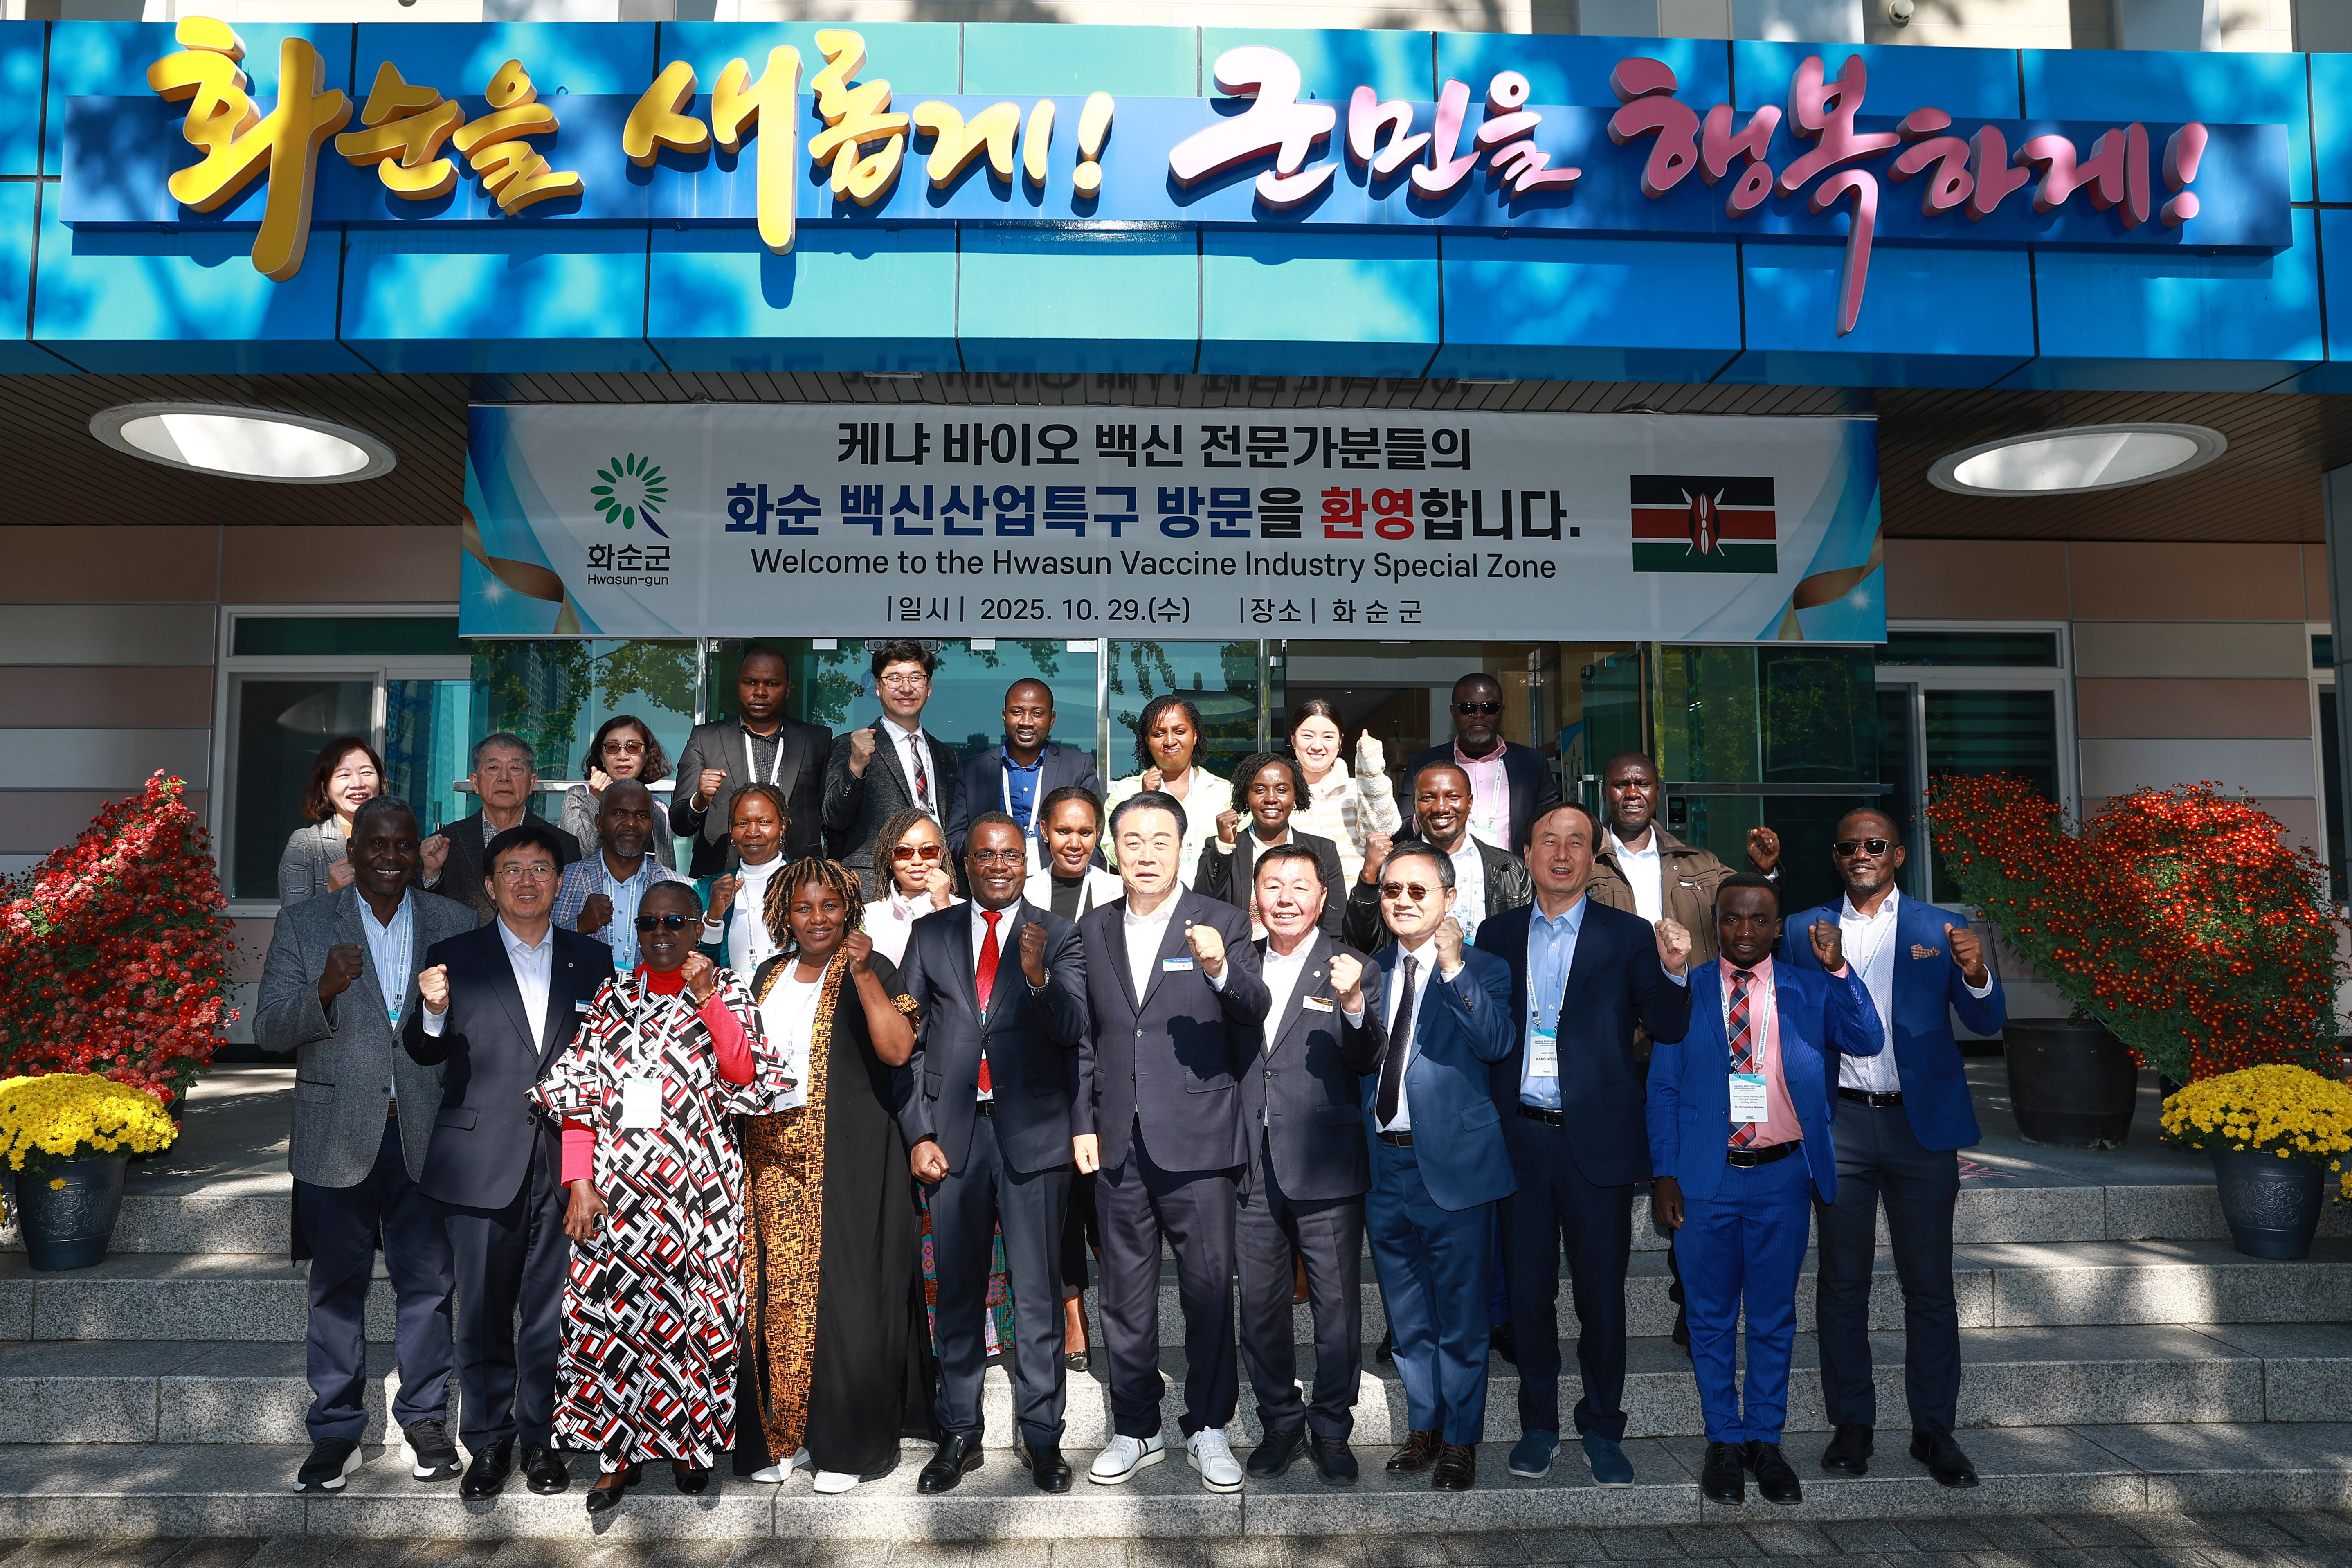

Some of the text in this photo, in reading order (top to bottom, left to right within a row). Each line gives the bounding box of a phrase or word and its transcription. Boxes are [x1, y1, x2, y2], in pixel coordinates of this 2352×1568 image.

[147, 16, 2208, 339] 화순을 새롭게! 군민을 행복하게!
[838, 423, 1470, 470] 케냐 바이오 백신 전문가분들의
[725, 483, 1580, 540] 화순 백신산업특구 방문을 환영합니다.
[587, 544, 670, 571] 화순군
[751, 549, 1556, 584] Welcome to the Hwasun Vaccine Industry Special Zone
[588, 574, 668, 586] Hwasun-gun
[981, 599, 1051, 619] 2025.
[1063, 599, 1098, 620] 10.
